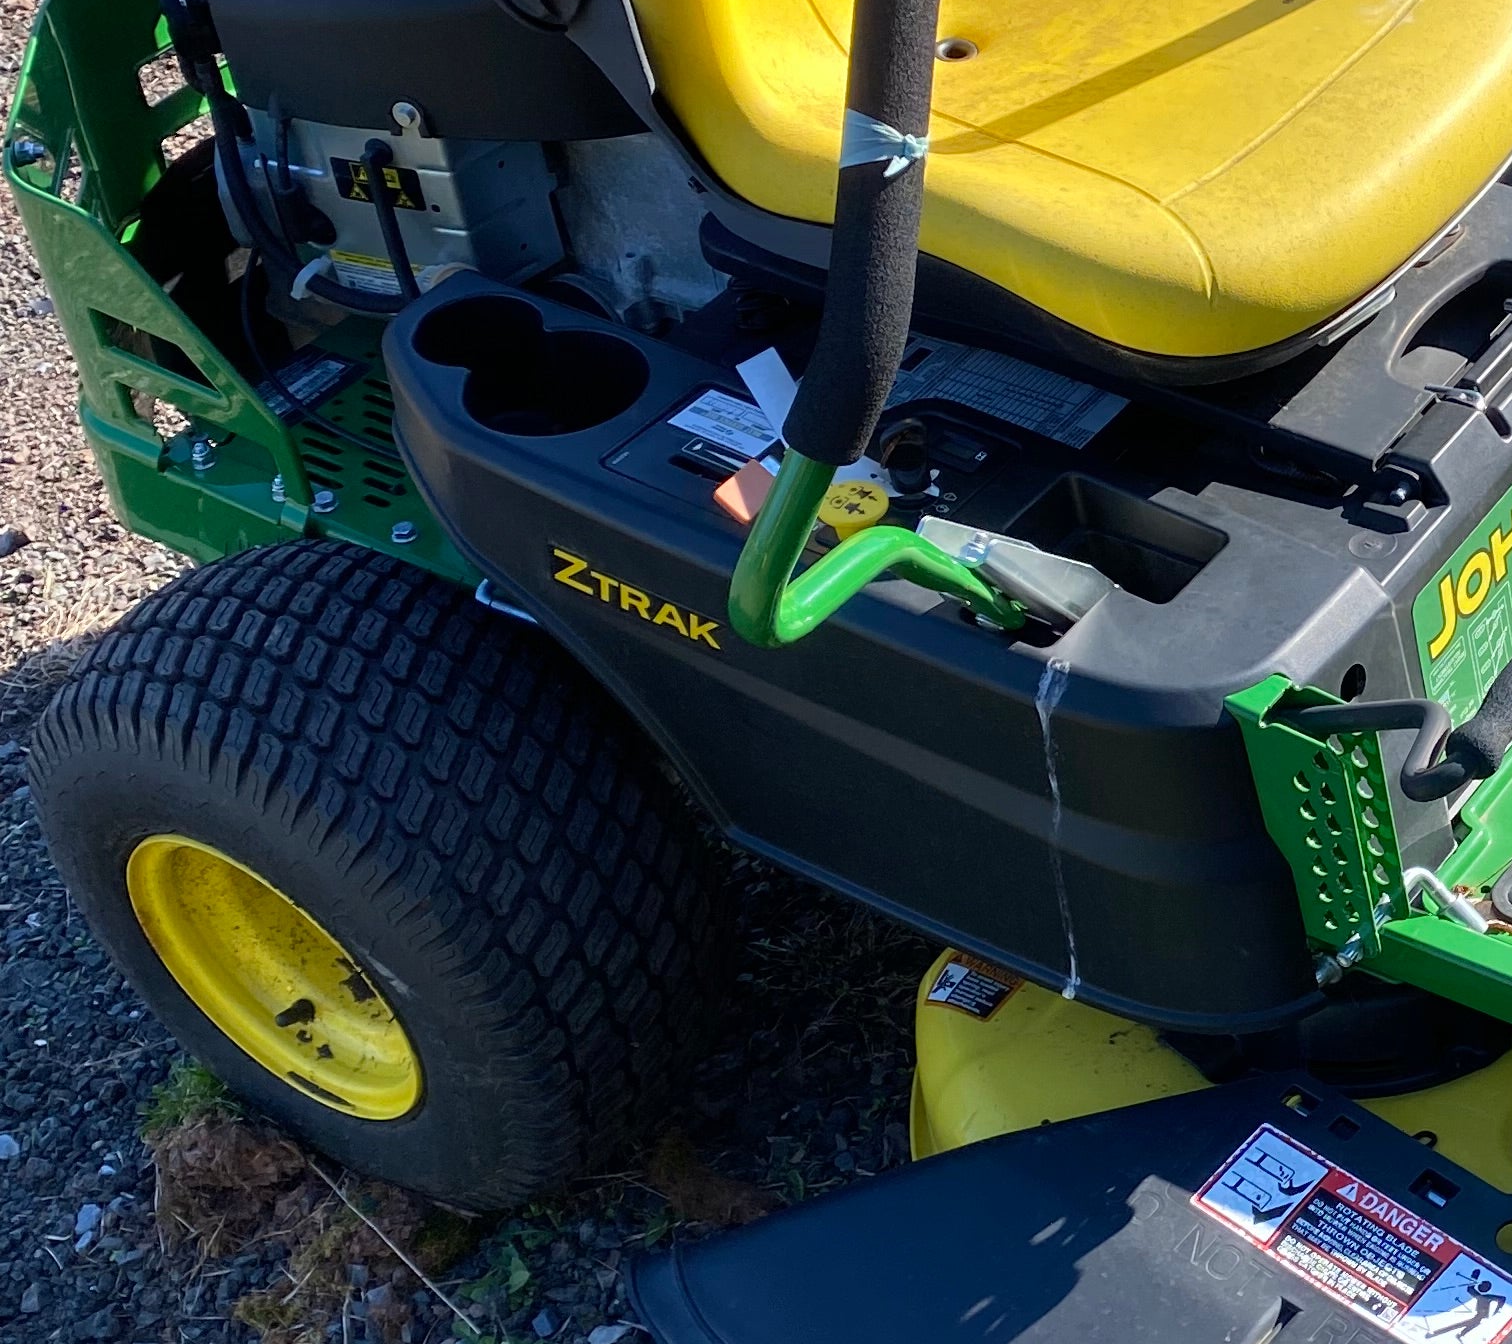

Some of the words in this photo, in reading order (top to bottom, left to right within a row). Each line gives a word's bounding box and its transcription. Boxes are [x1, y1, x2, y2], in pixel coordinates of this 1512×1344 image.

[553, 548, 721, 650] ZTRAK
[1315, 1219, 1361, 1251] THROWN
[1358, 1246, 1406, 1280] OBJECTS
[1334, 1202, 1386, 1237] ROTATING
[1384, 1233, 1420, 1258] BLADE
[1356, 1191, 1446, 1253] DANGER
[1174, 1224, 1275, 1298] NOT
